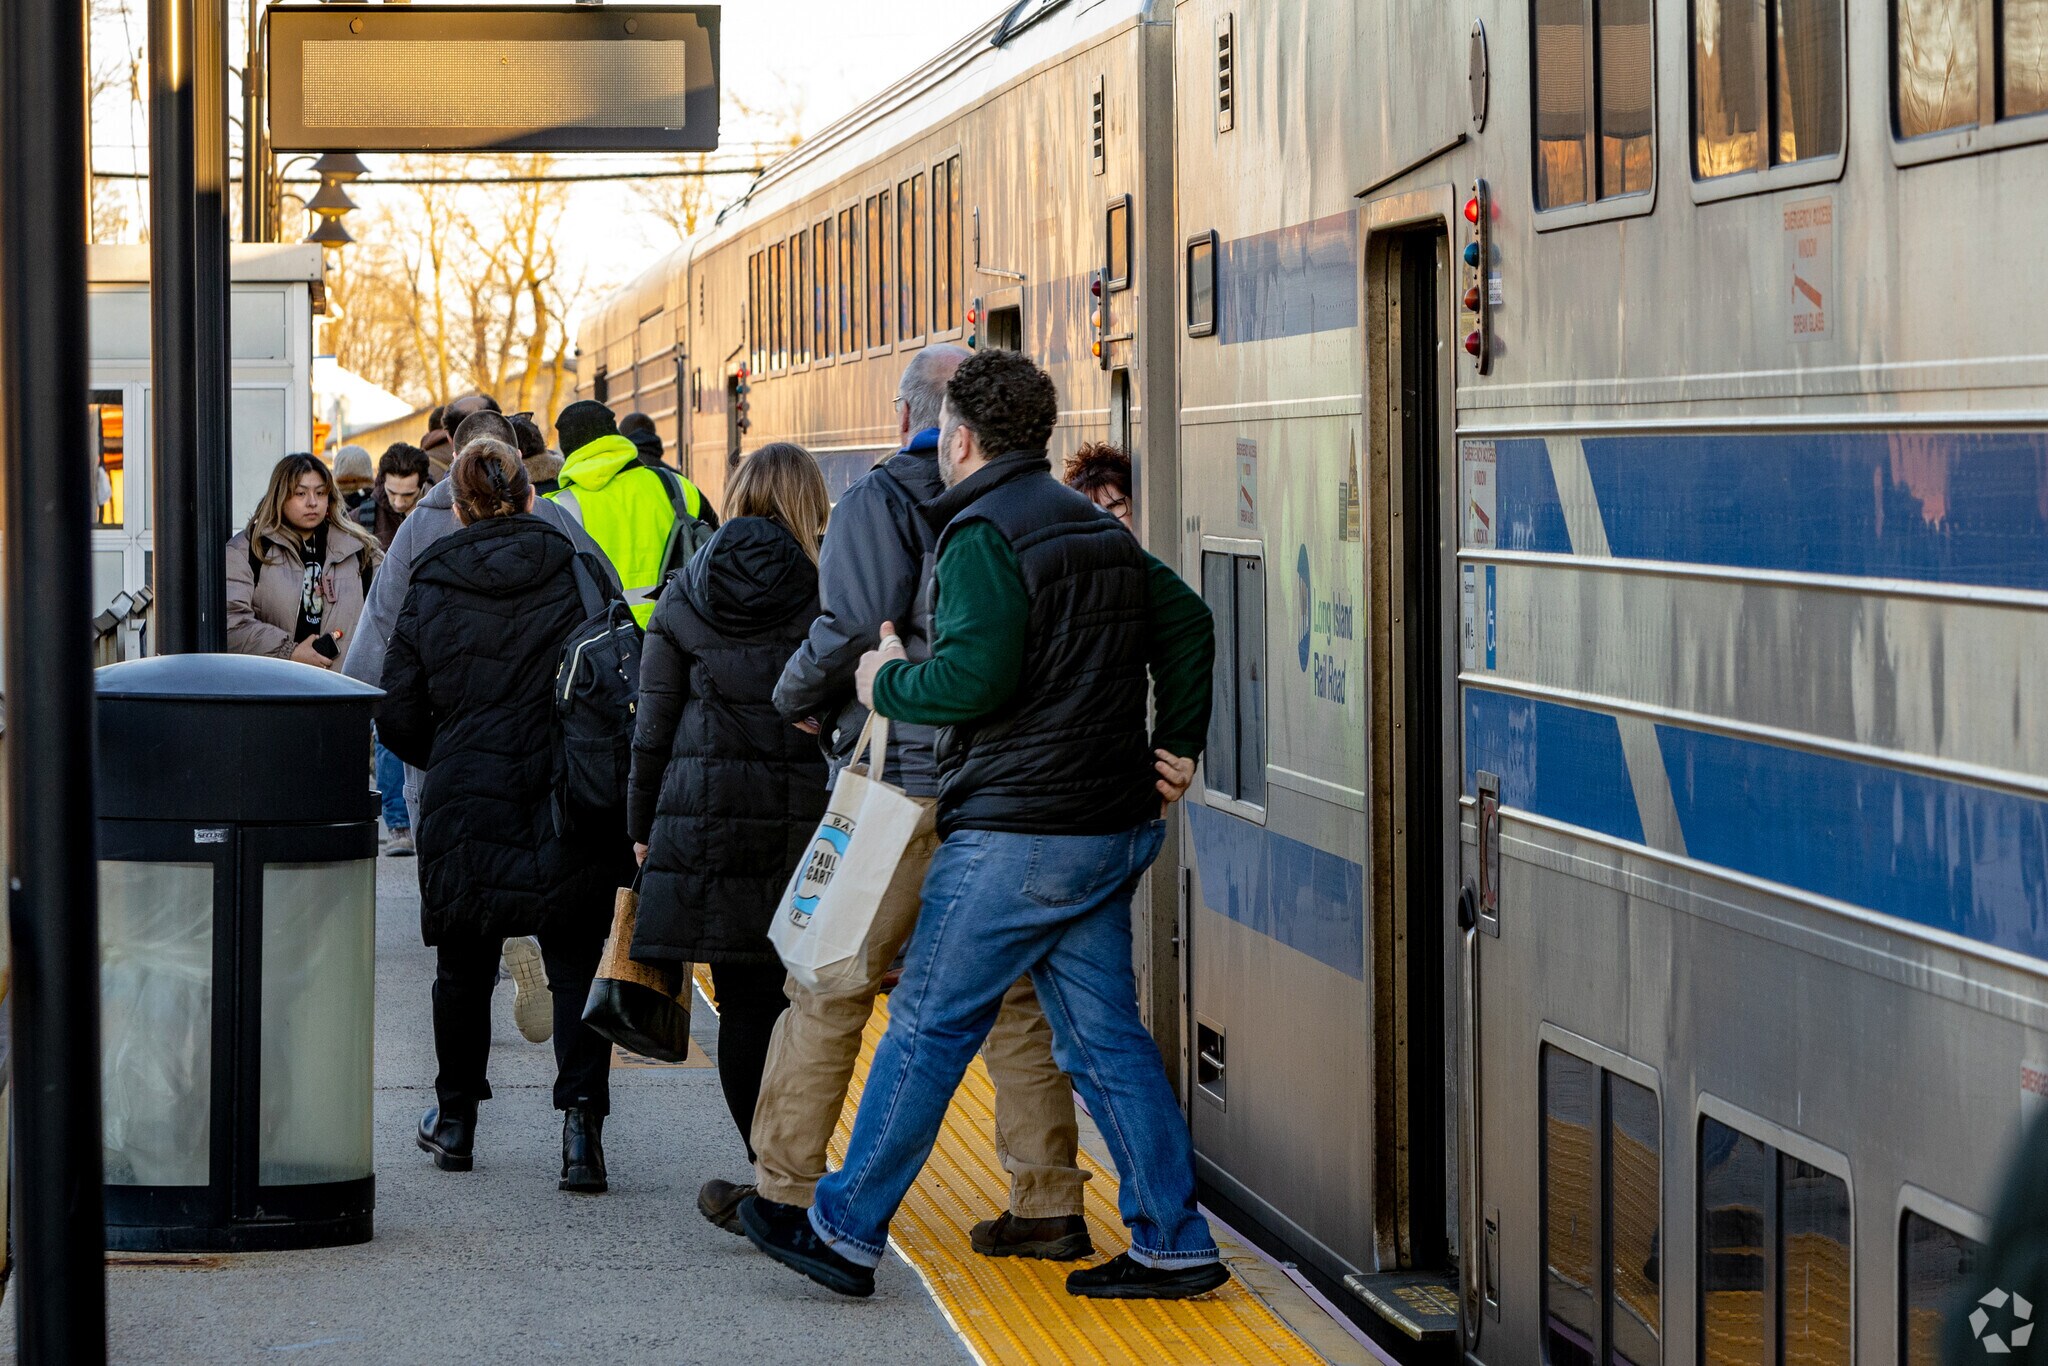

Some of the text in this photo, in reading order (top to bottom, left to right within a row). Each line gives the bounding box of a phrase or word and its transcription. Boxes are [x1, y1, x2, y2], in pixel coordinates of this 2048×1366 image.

[1313, 587, 1332, 646] Long
[1332, 590, 1353, 641] Island
[1313, 651, 1347, 705] Rail Road
[810, 850, 837, 871] PAUL
